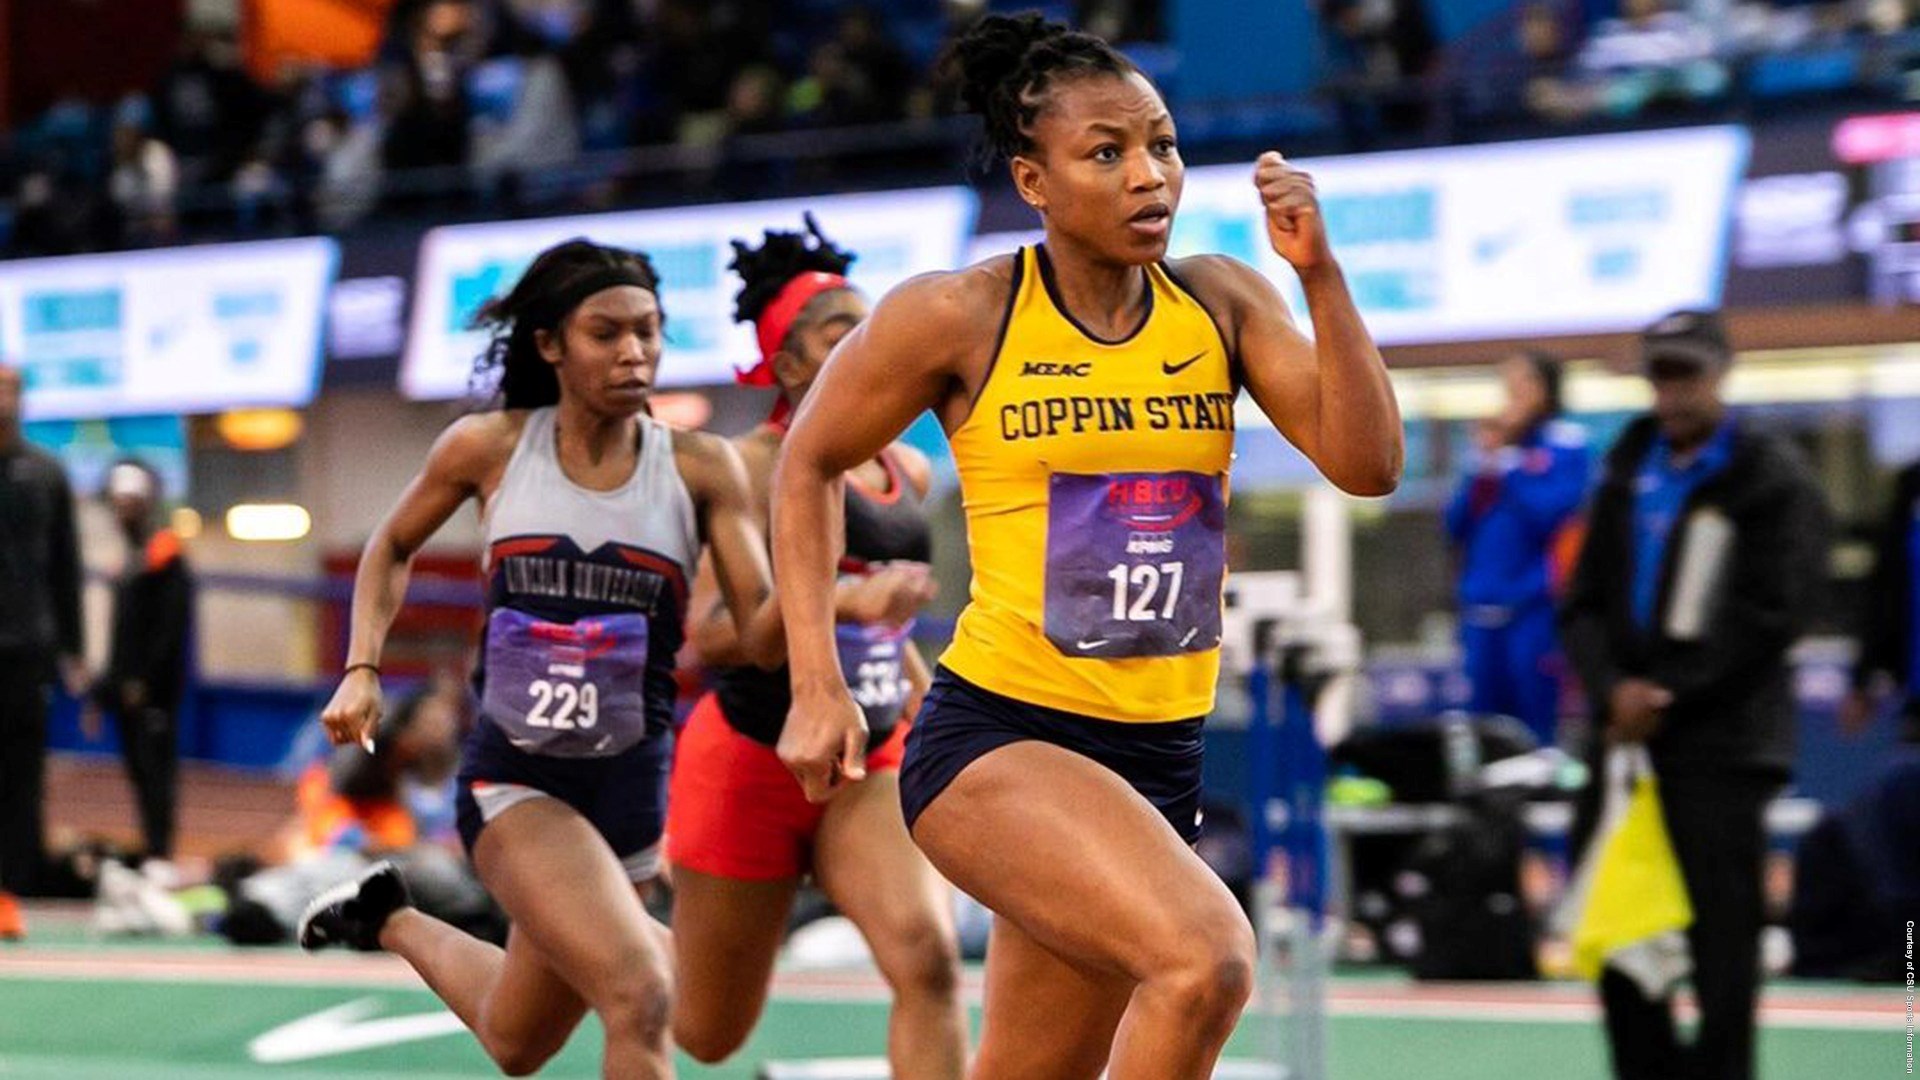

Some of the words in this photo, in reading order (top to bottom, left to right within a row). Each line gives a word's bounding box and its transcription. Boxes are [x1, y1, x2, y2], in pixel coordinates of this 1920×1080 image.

[1019, 362, 1092, 377] MEAC
[1001, 397, 1135, 441] COPPIN
[505, 556, 568, 596] LINCOLN
[1107, 562, 1183, 621] 127
[526, 679, 598, 729] 229
